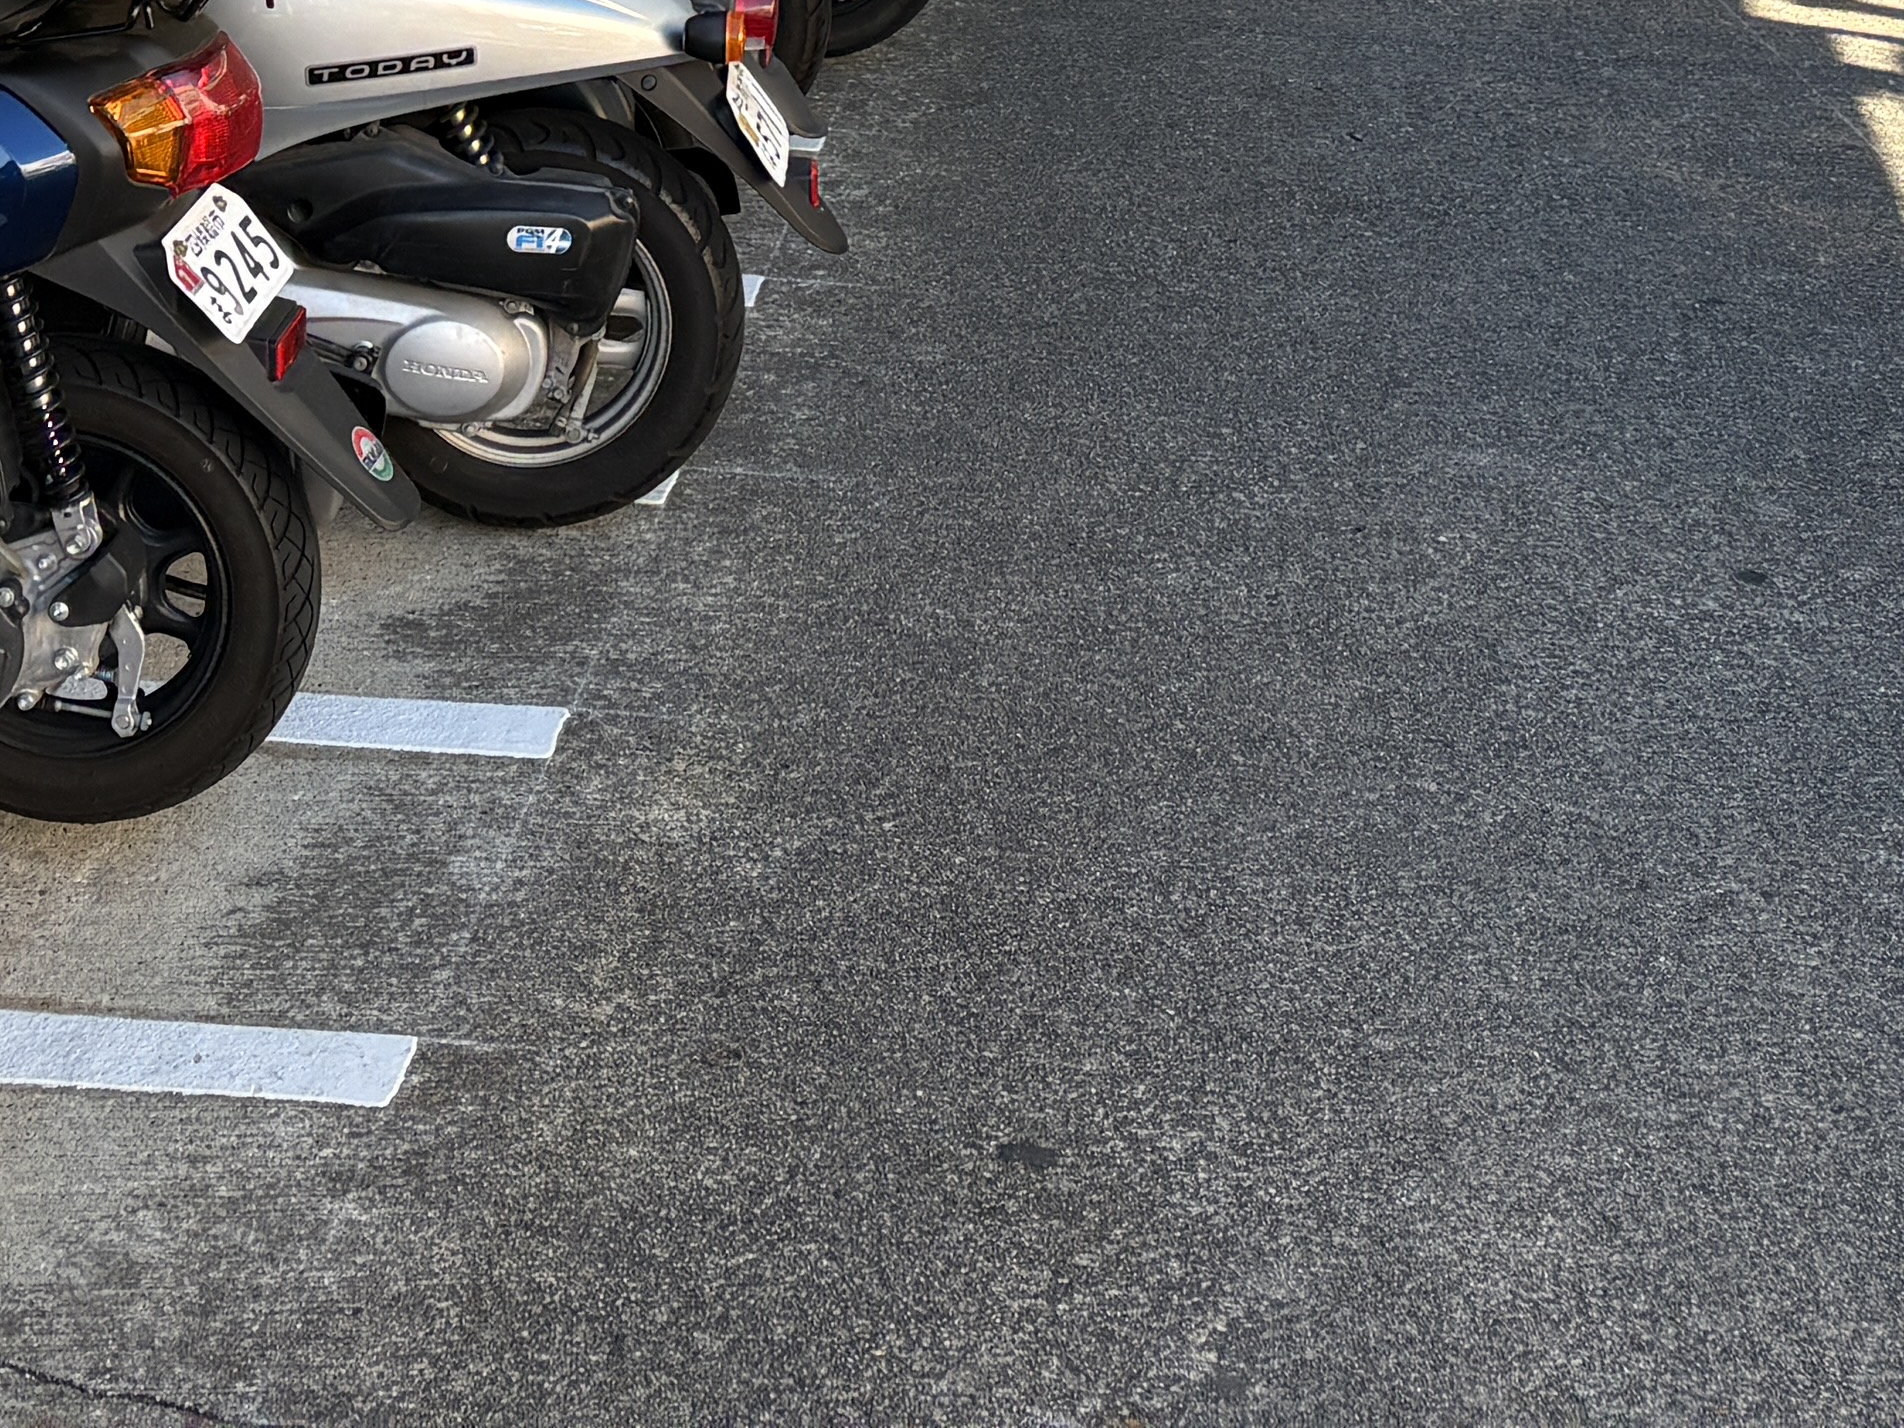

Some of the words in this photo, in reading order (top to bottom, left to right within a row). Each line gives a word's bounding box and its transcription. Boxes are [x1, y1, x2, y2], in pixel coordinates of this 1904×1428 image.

[313, 50, 468, 82] TODAY
[200, 214, 280, 316] 9245
[402, 358, 489, 384] HONDA
